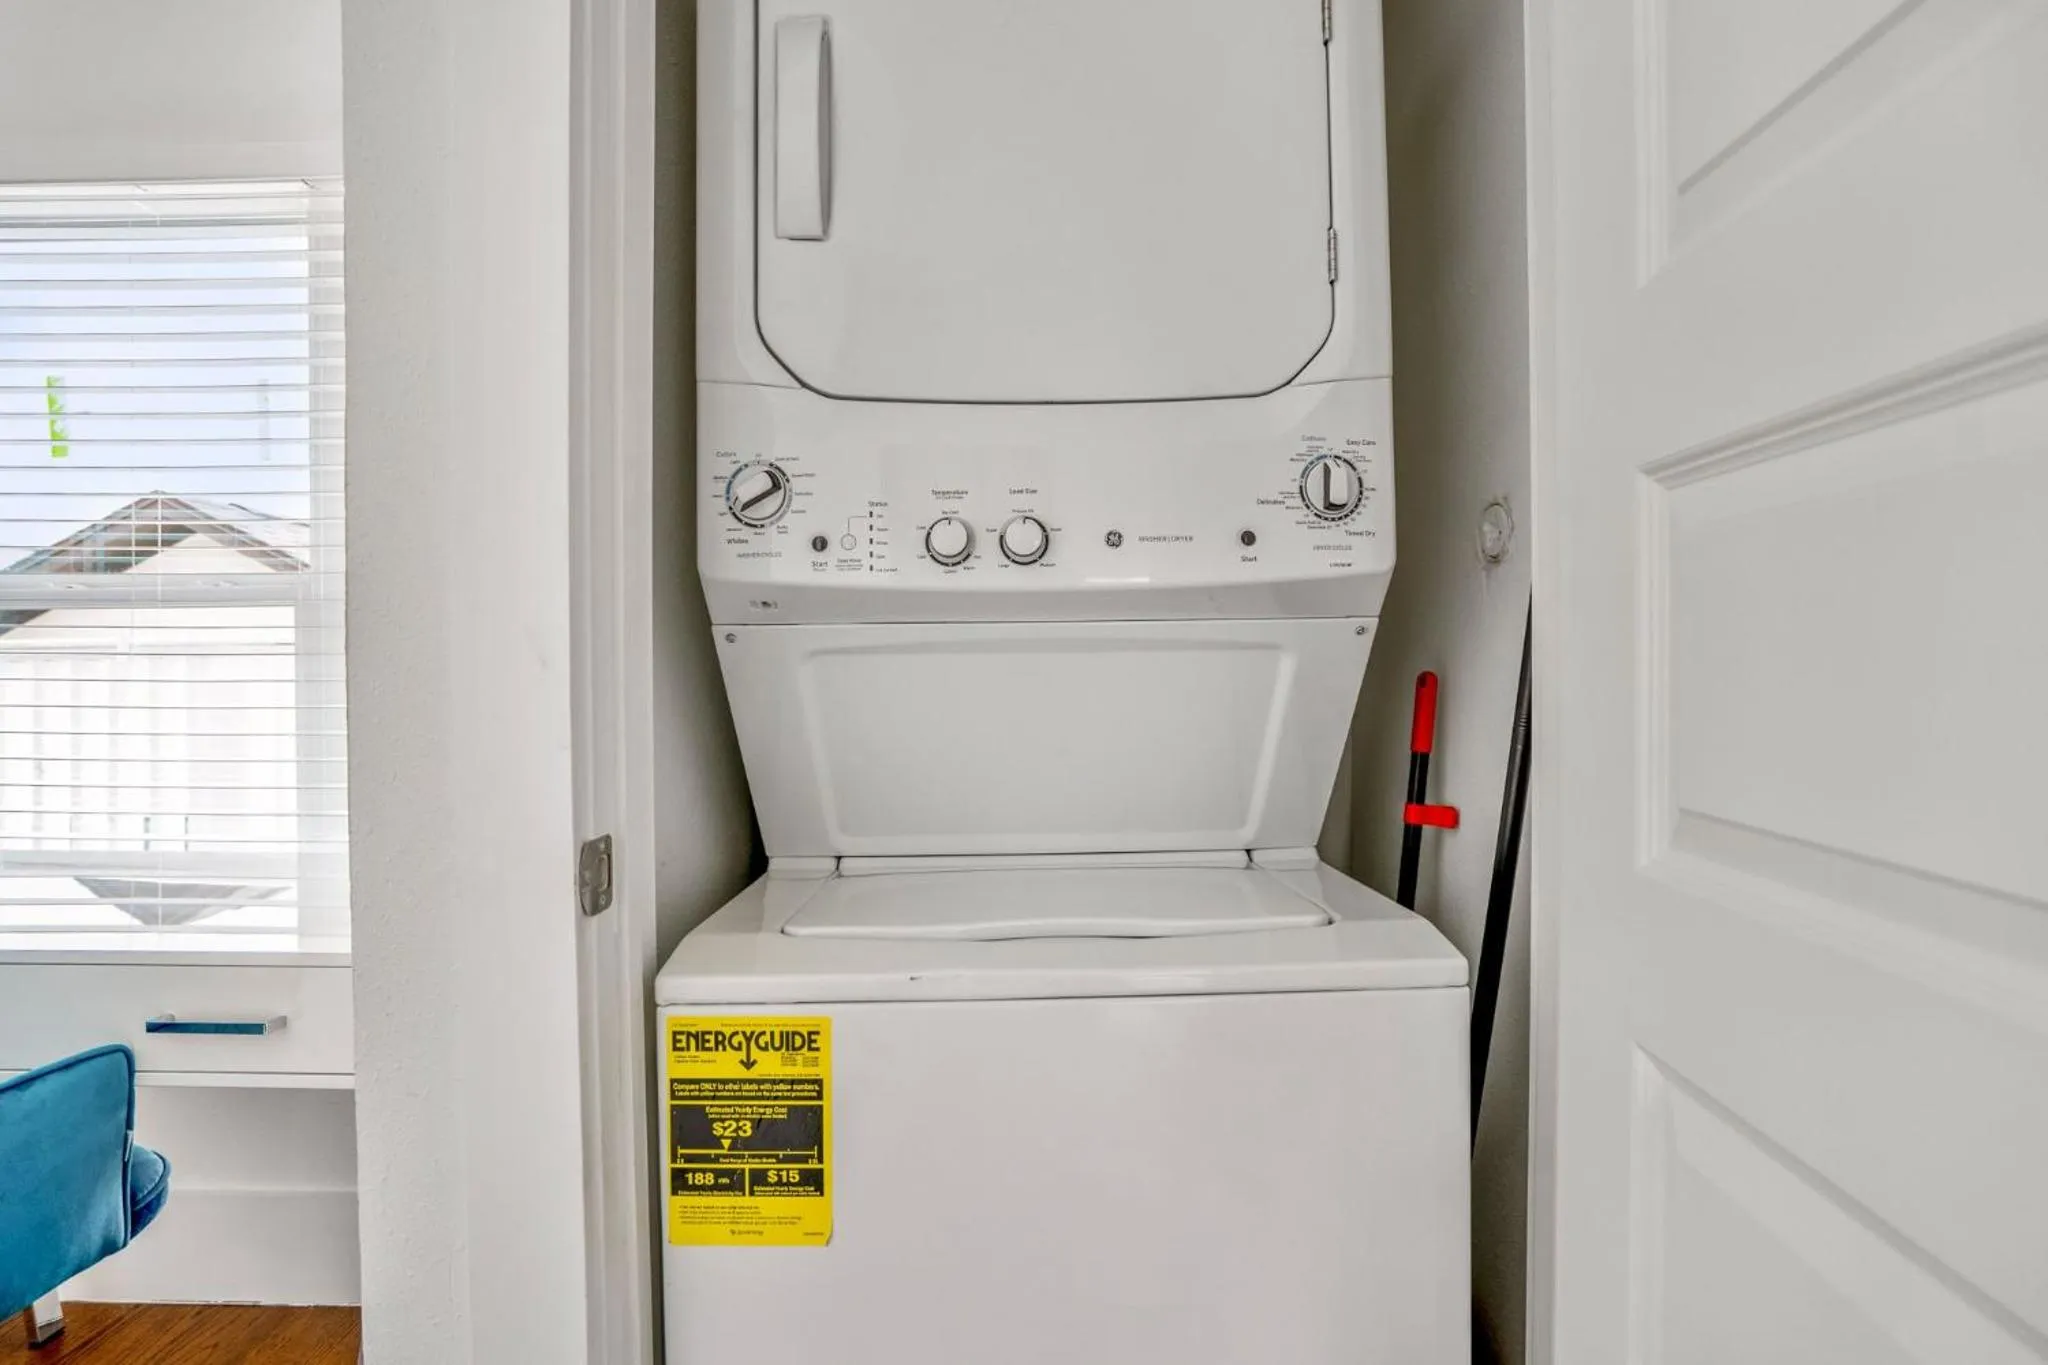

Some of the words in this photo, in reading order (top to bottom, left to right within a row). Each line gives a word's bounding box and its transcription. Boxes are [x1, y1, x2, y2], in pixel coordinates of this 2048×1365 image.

[1346, 438, 1361, 446] Easy
[1364, 530, 1376, 538] Dry
[1240, 555, 1257, 563] Start
[811, 560, 828, 568] Start
[672, 1030, 821, 1055] ENERGYGUIDE
[672, 1082, 699, 1092] Compare
[700, 1082, 716, 1090] ONLY
[717, 1083, 725, 1091] to
[725, 1082, 741, 1090] other
[741, 1082, 759, 1090] labels
[772, 1083, 792, 1092] yellow
[792, 1083, 820, 1091] numbers.
[734, 1106, 752, 1114] Yearly
[753, 1106, 773, 1115] Energy
[712, 1120, 752, 1137] $23
[684, 1172, 714, 1185] 188
[767, 1169, 800, 1184] $15
